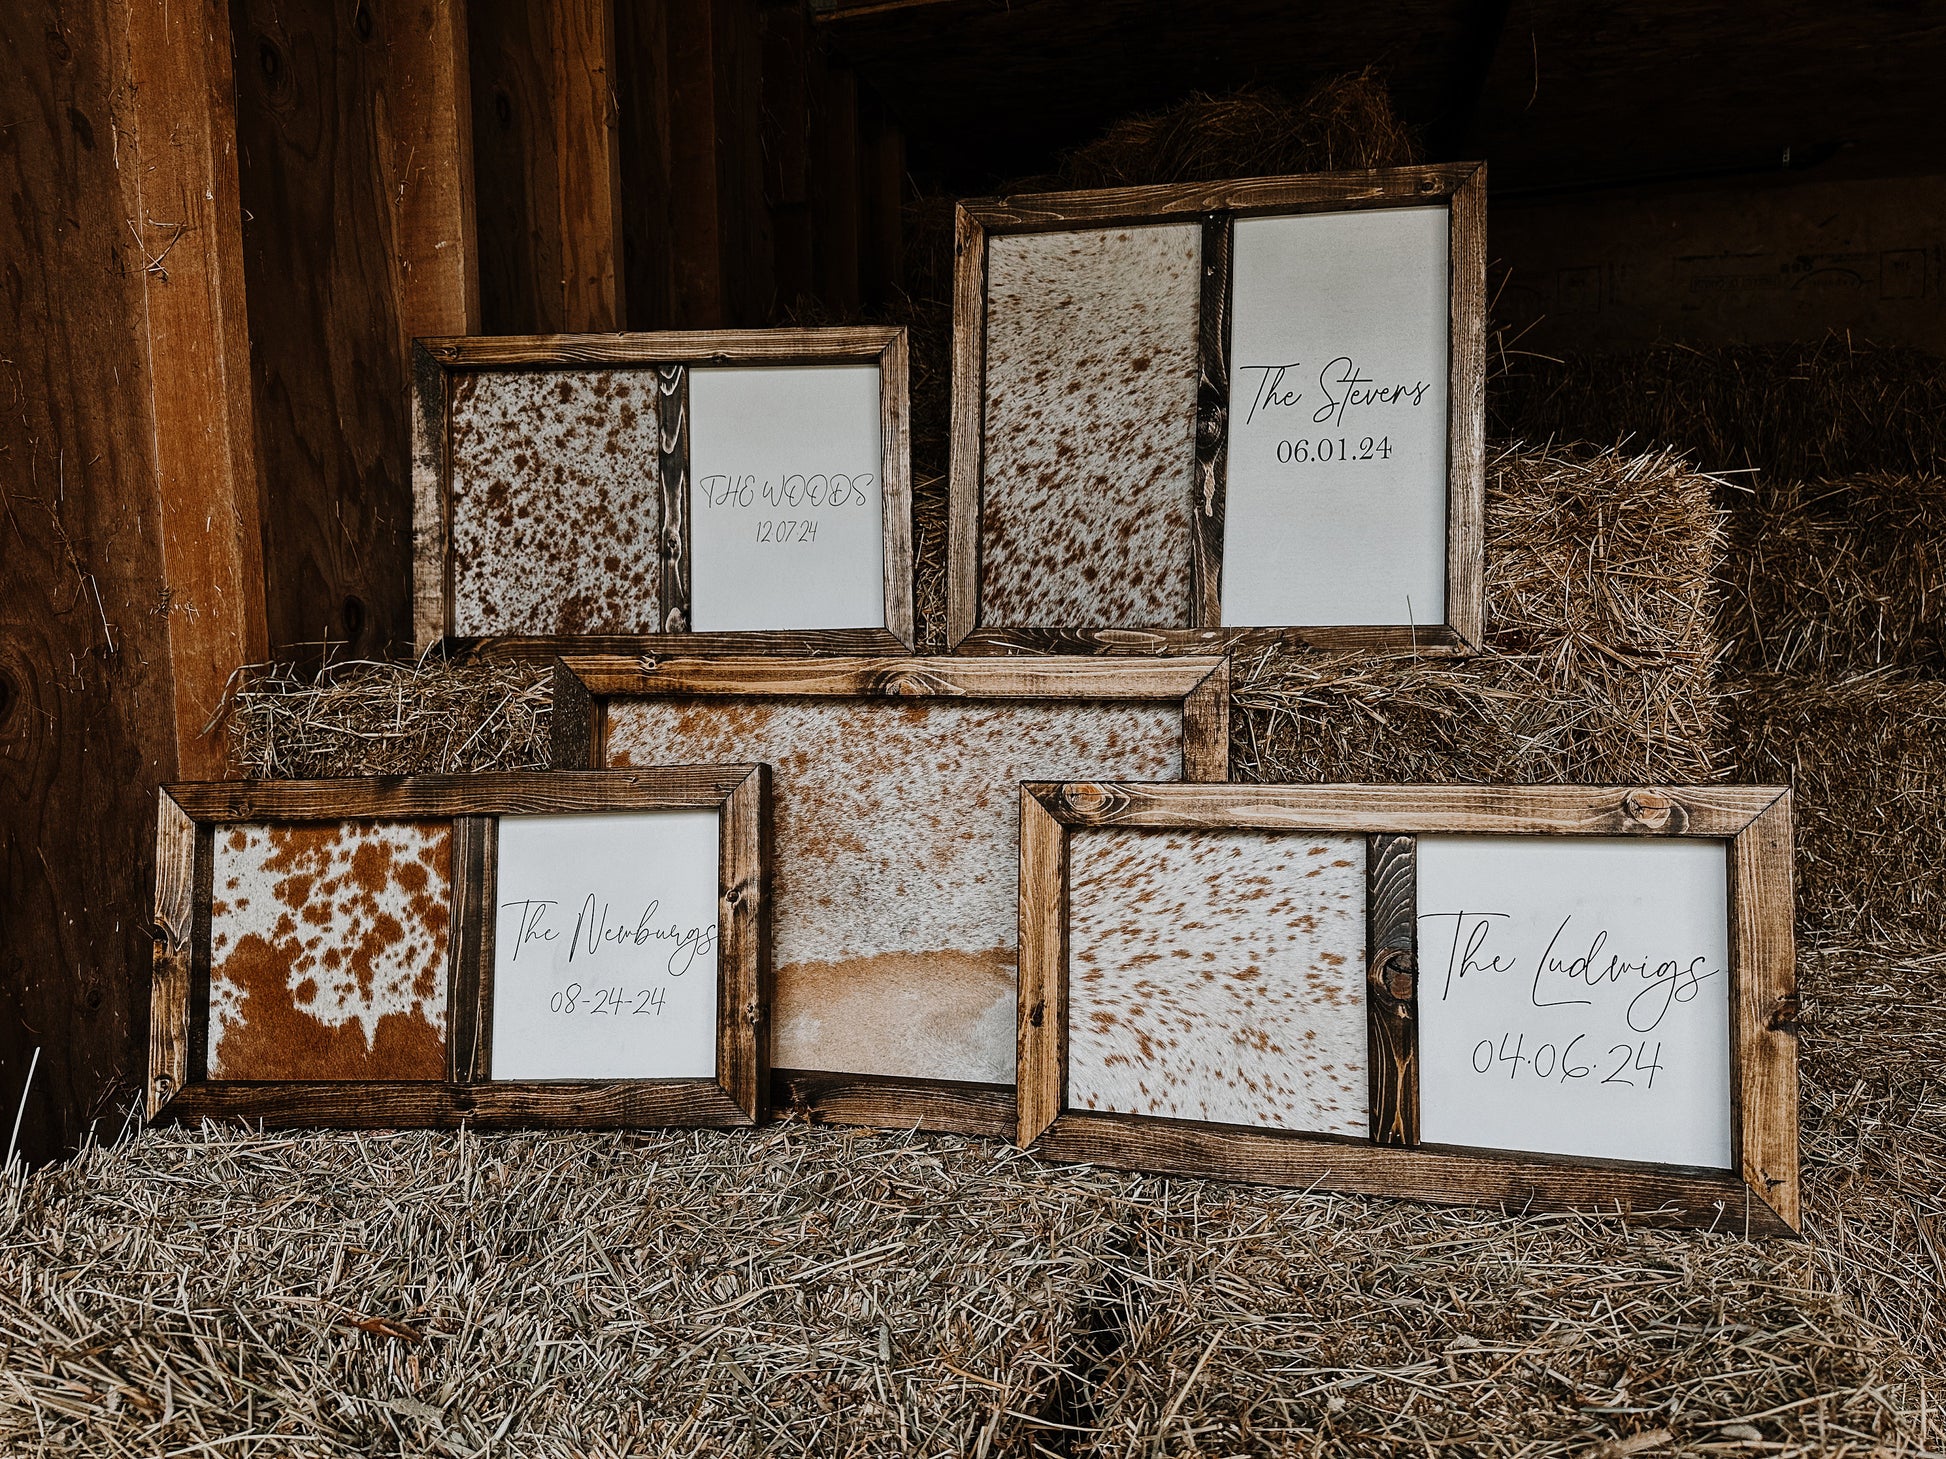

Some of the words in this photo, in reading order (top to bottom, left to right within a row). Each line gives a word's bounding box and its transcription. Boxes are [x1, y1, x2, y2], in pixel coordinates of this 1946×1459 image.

[1239, 362, 1303, 426] The
[1312, 356, 1431, 428] Stevens
[1276, 435, 1393, 464] 06.01.24
[699, 474, 756, 509] THE
[762, 472, 875, 508] WOODS
[500, 898, 561, 962] The
[568, 892, 718, 977] Newburgs
[1418, 909, 1517, 1001] The
[1531, 913, 1720, 1033] Ludwigs
[550, 982, 666, 1016] 08-24-24
